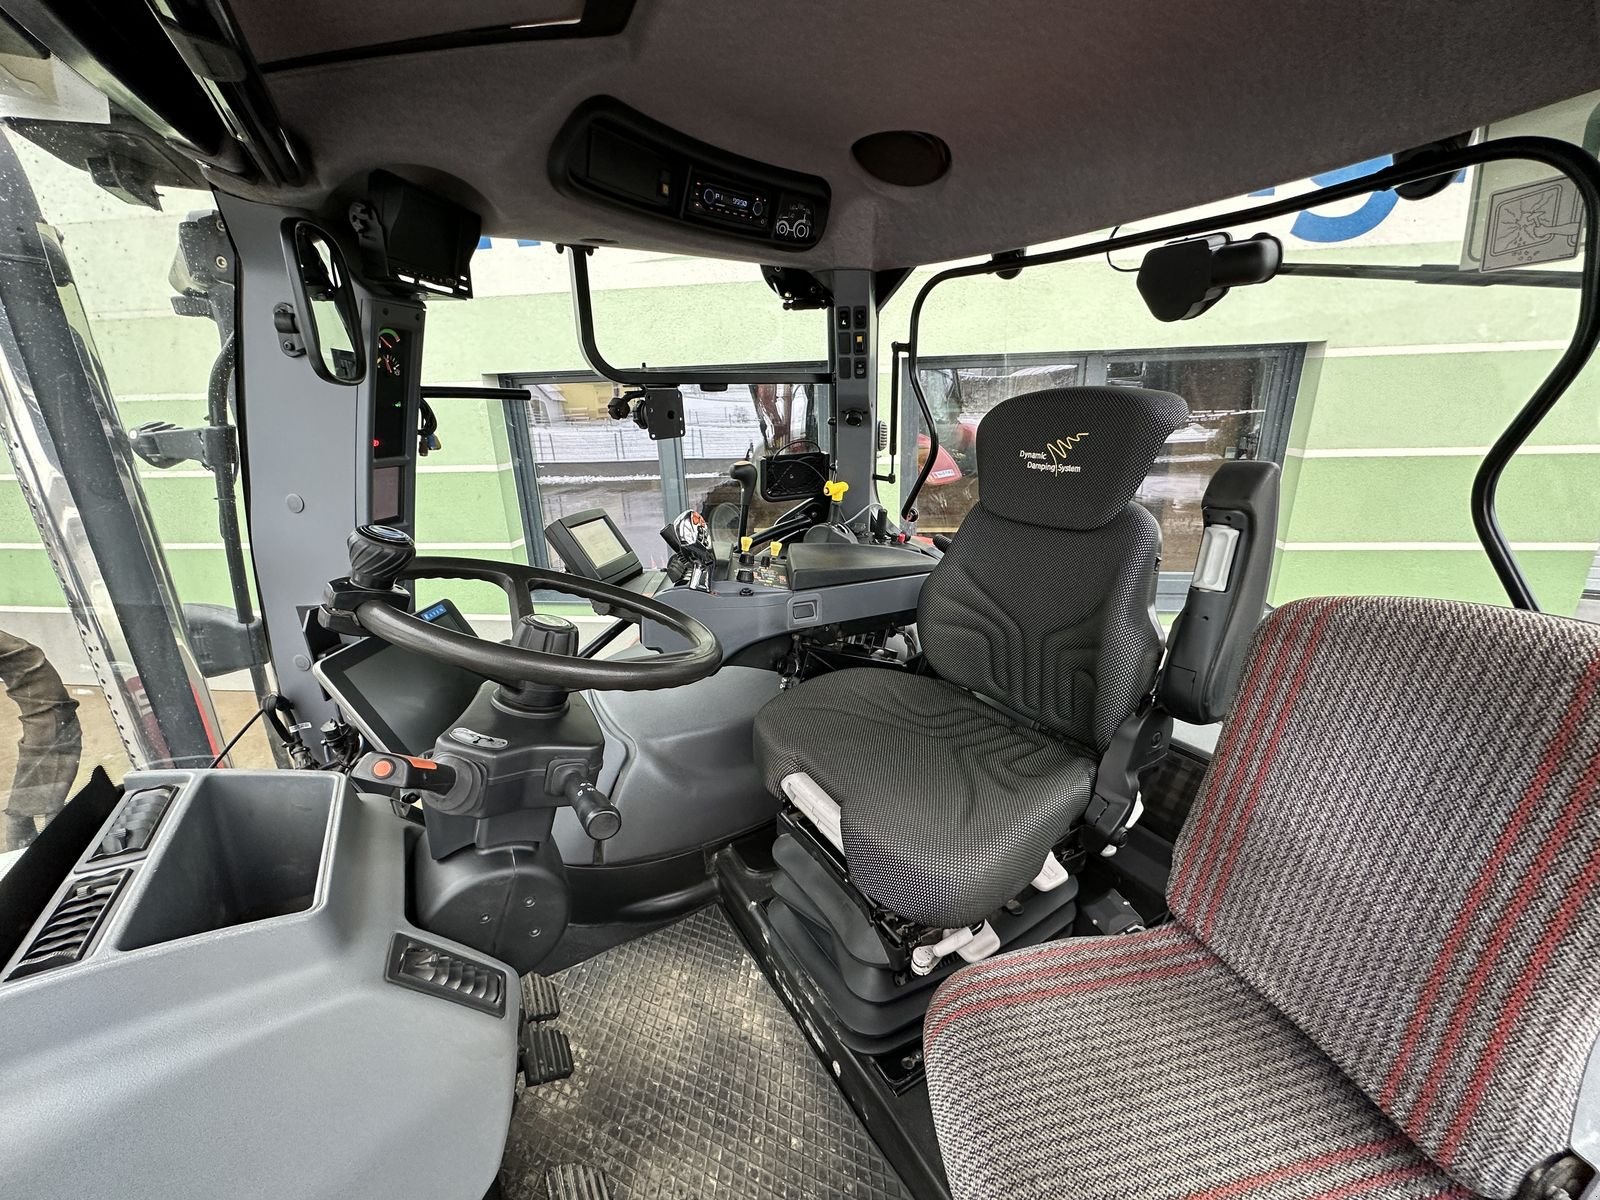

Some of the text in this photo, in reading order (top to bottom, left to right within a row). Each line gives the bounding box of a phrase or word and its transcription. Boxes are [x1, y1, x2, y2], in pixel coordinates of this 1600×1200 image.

[1019, 450, 1047, 459] Dynamic
[1027, 461, 1081, 473] Damping System
